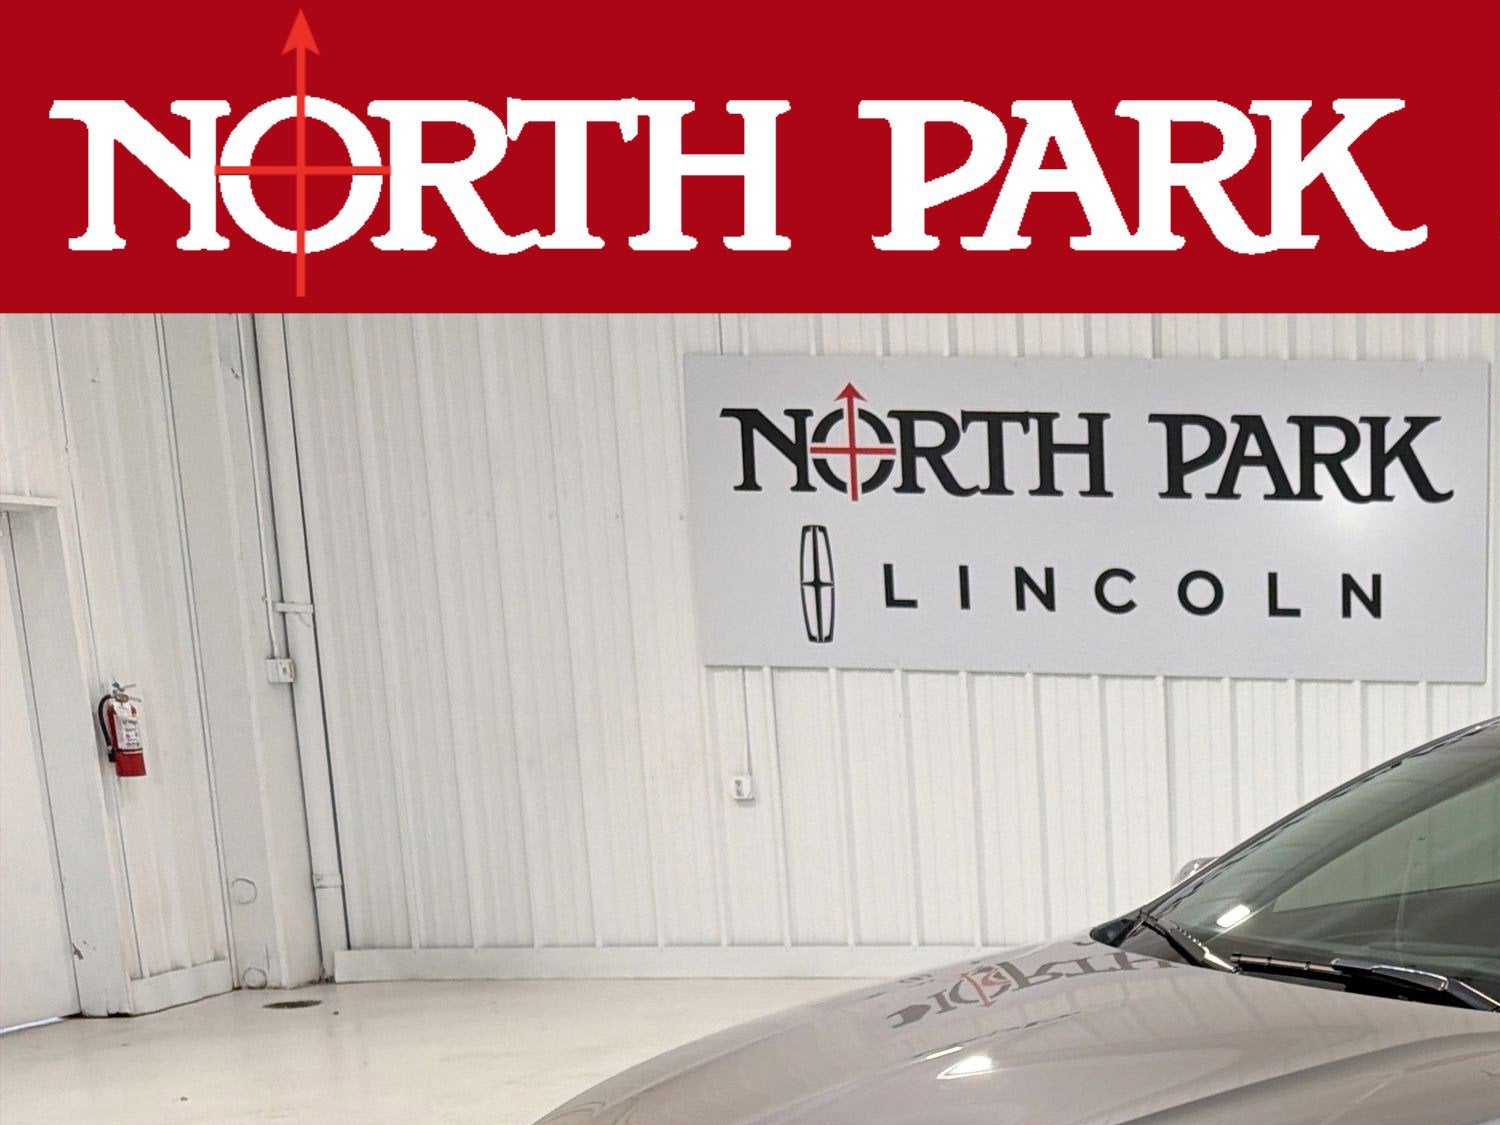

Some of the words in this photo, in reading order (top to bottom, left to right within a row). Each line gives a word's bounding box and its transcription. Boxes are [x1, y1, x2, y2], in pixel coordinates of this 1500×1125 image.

[720, 407, 1114, 499] NORTH
[1148, 413, 1455, 504] PARK
[883, 562, 1384, 619] LINCOLN
